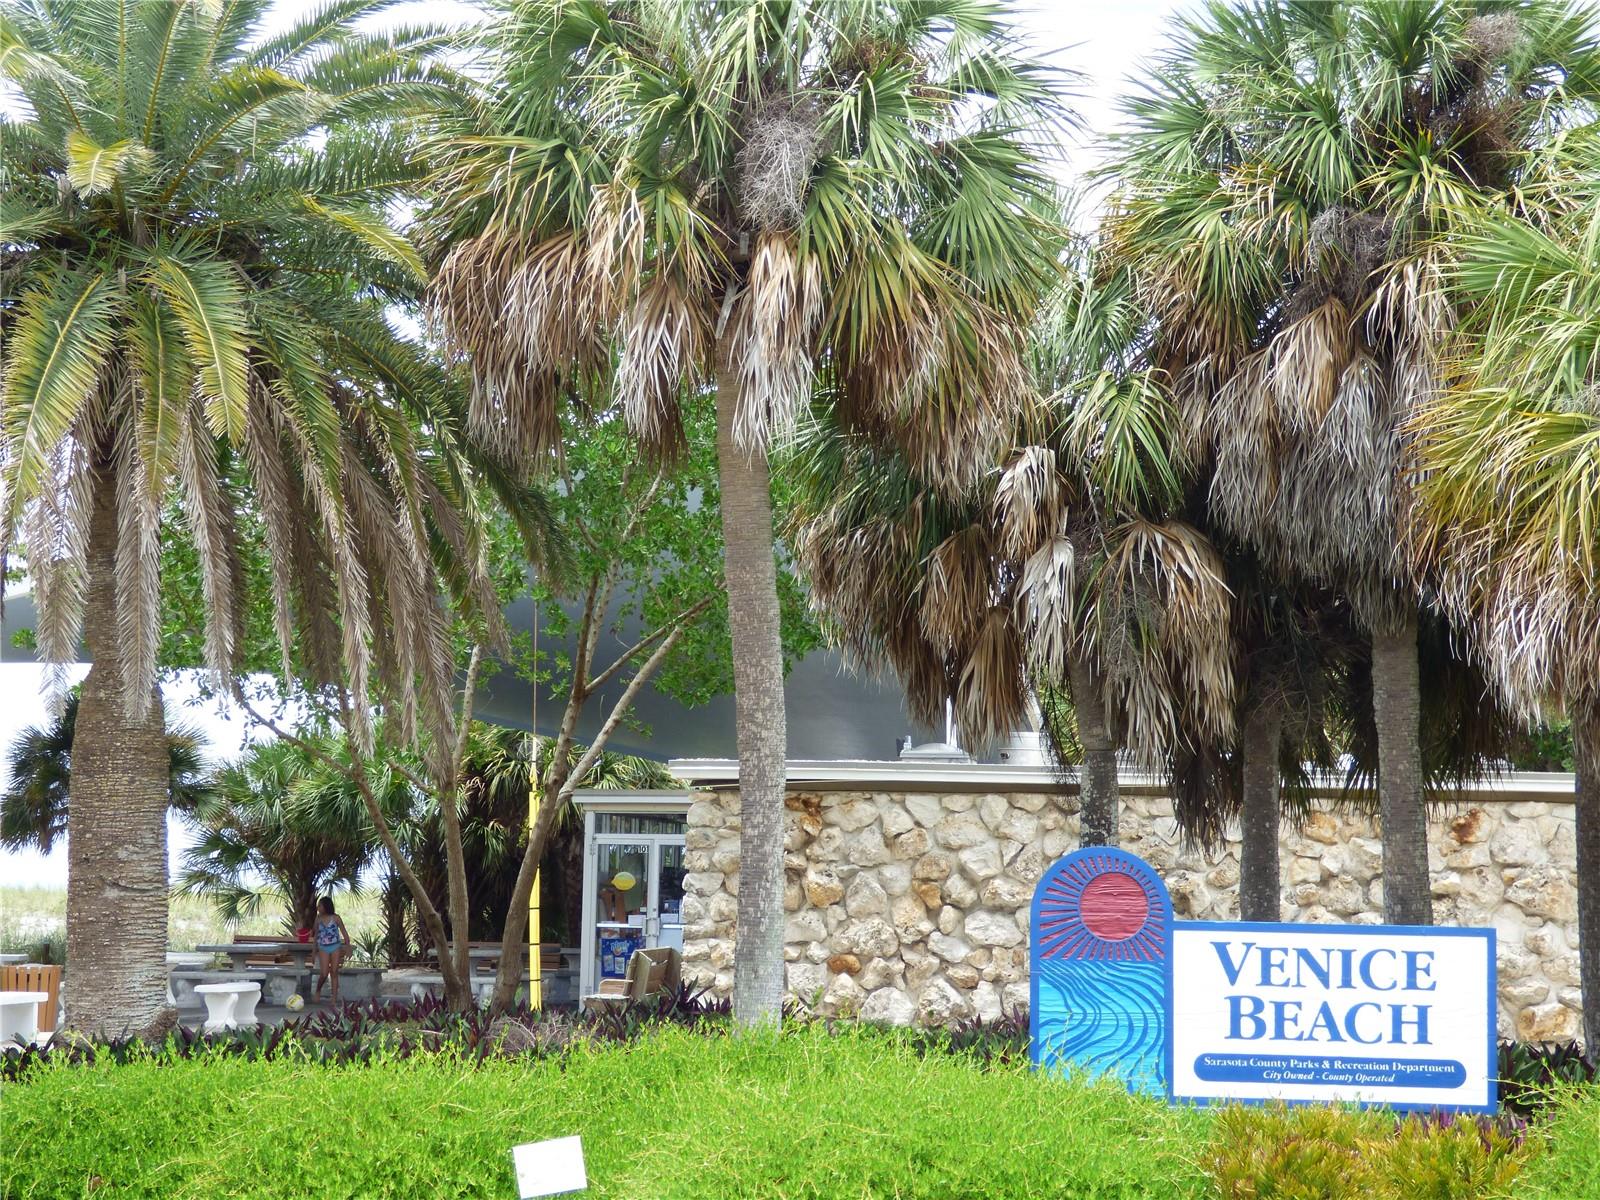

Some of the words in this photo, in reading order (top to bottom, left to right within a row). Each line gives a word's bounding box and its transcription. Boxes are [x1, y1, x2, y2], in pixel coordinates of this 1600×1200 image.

[1210, 941, 1437, 992] VENICE
[1224, 995, 1434, 1045] BEACH
[1204, 1056, 1247, 1067] Sarasota
[1249, 1057, 1288, 1070] County
[1290, 1059, 1319, 1069] Parks
[1321, 1060, 1331, 1069] &
[1334, 1060, 1390, 1072] Recreation
[1392, 1062, 1456, 1074] Department
[1263, 1070, 1282, 1081] City
[1283, 1071, 1314, 1081] Owned
[1322, 1072, 1353, 1083] County
[1355, 1073, 1396, 1084] Operated
